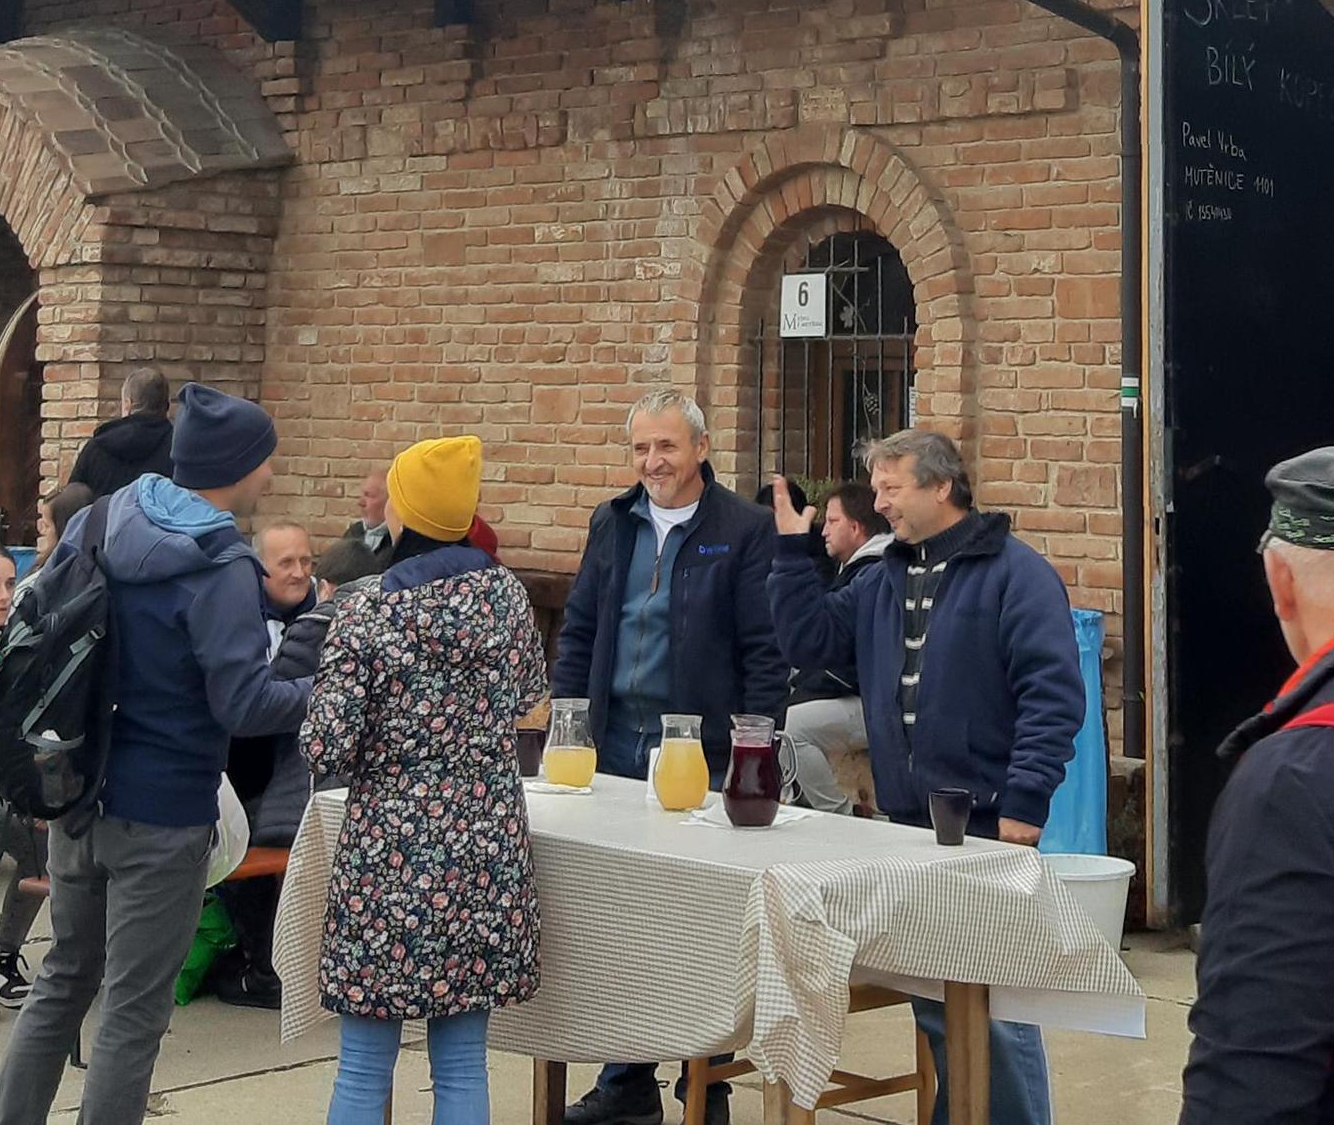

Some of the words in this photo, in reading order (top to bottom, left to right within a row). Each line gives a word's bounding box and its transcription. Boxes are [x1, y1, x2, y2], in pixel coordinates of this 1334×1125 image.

[1206, 39, 1256, 91] BÍLÝ
[1182, 121, 1212, 149] Pavel
[1217, 130, 1247, 161] Vrba
[798, 280, 809, 307] 6
